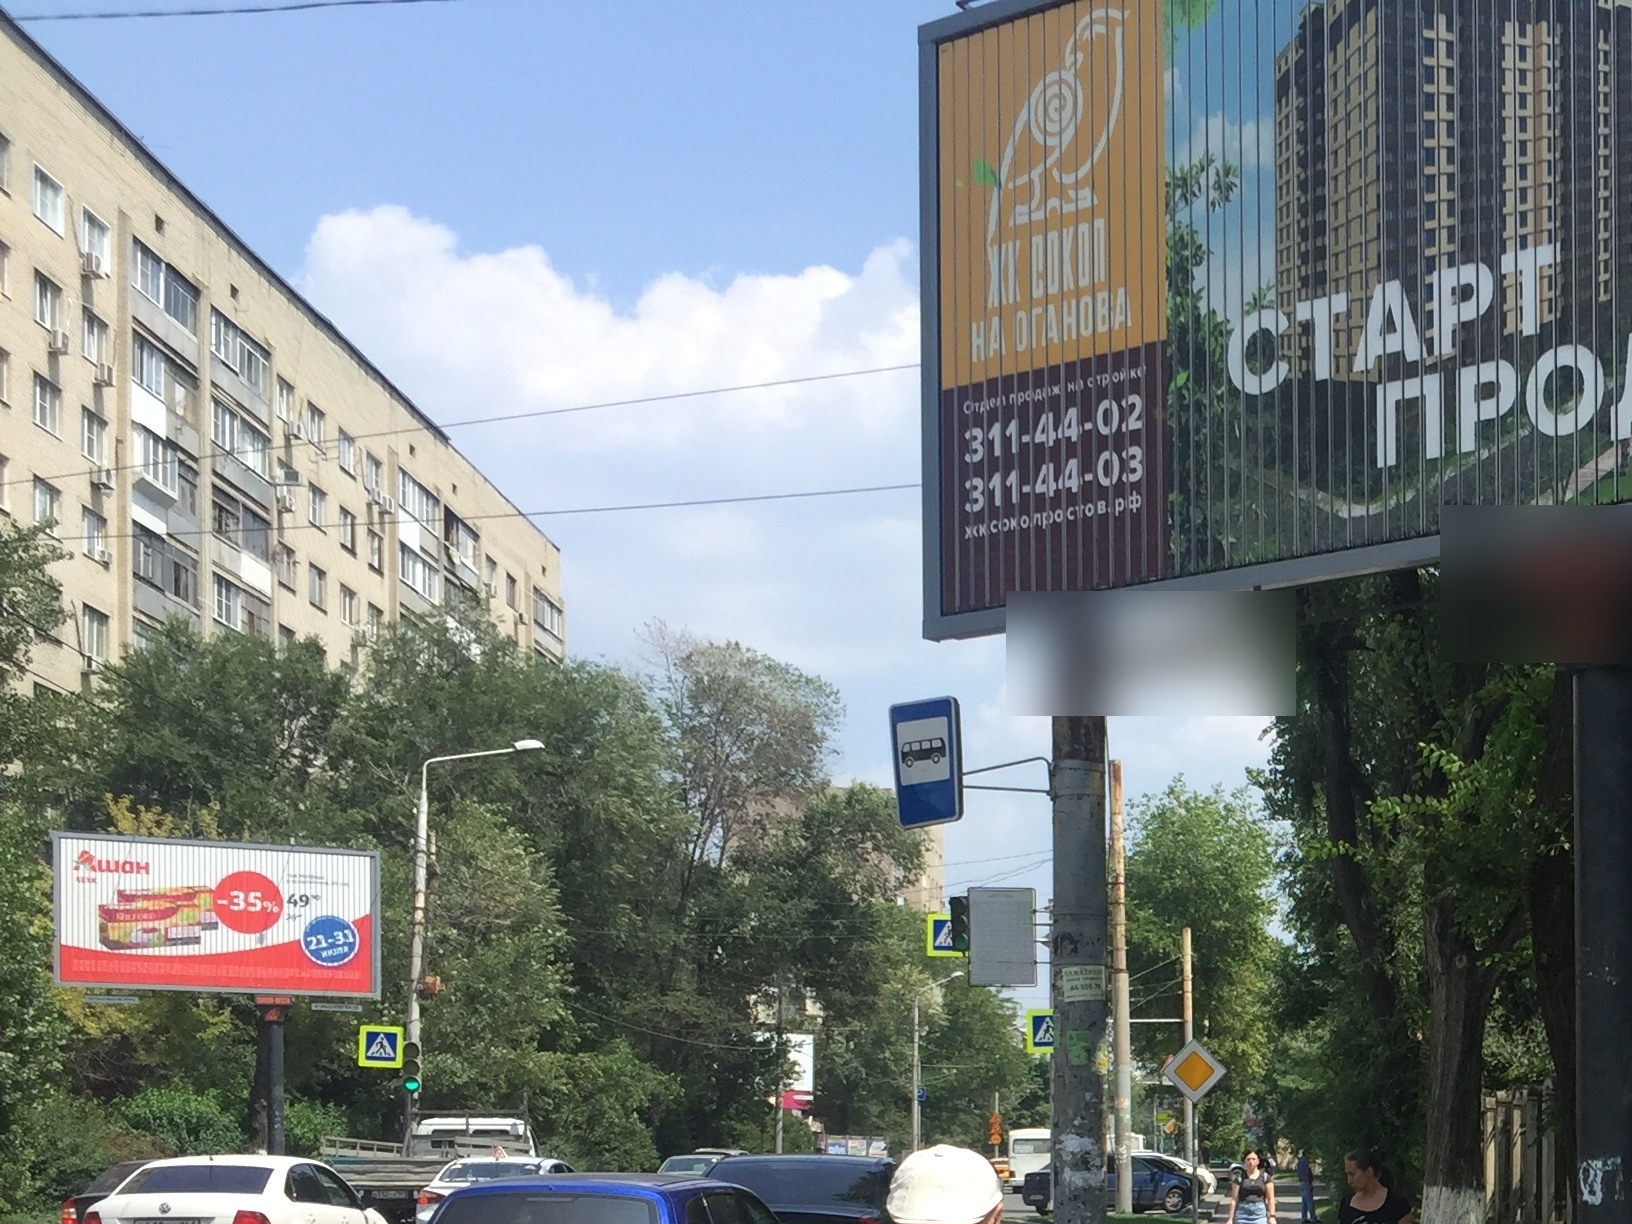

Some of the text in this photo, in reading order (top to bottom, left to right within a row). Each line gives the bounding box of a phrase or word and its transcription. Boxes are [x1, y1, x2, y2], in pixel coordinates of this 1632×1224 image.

[971, 287, 1133, 363] НА ОГАНОВА
[1227, 243, 1562, 396] СТАРТ
[1009, 386, 1061, 406] продаж
[1067, 379, 1085, 393] на
[963, 393, 1144, 464] 311-44-02
[964, 445, 1144, 514] 311-44-03
[306, 929, 355, 951] 21-31
